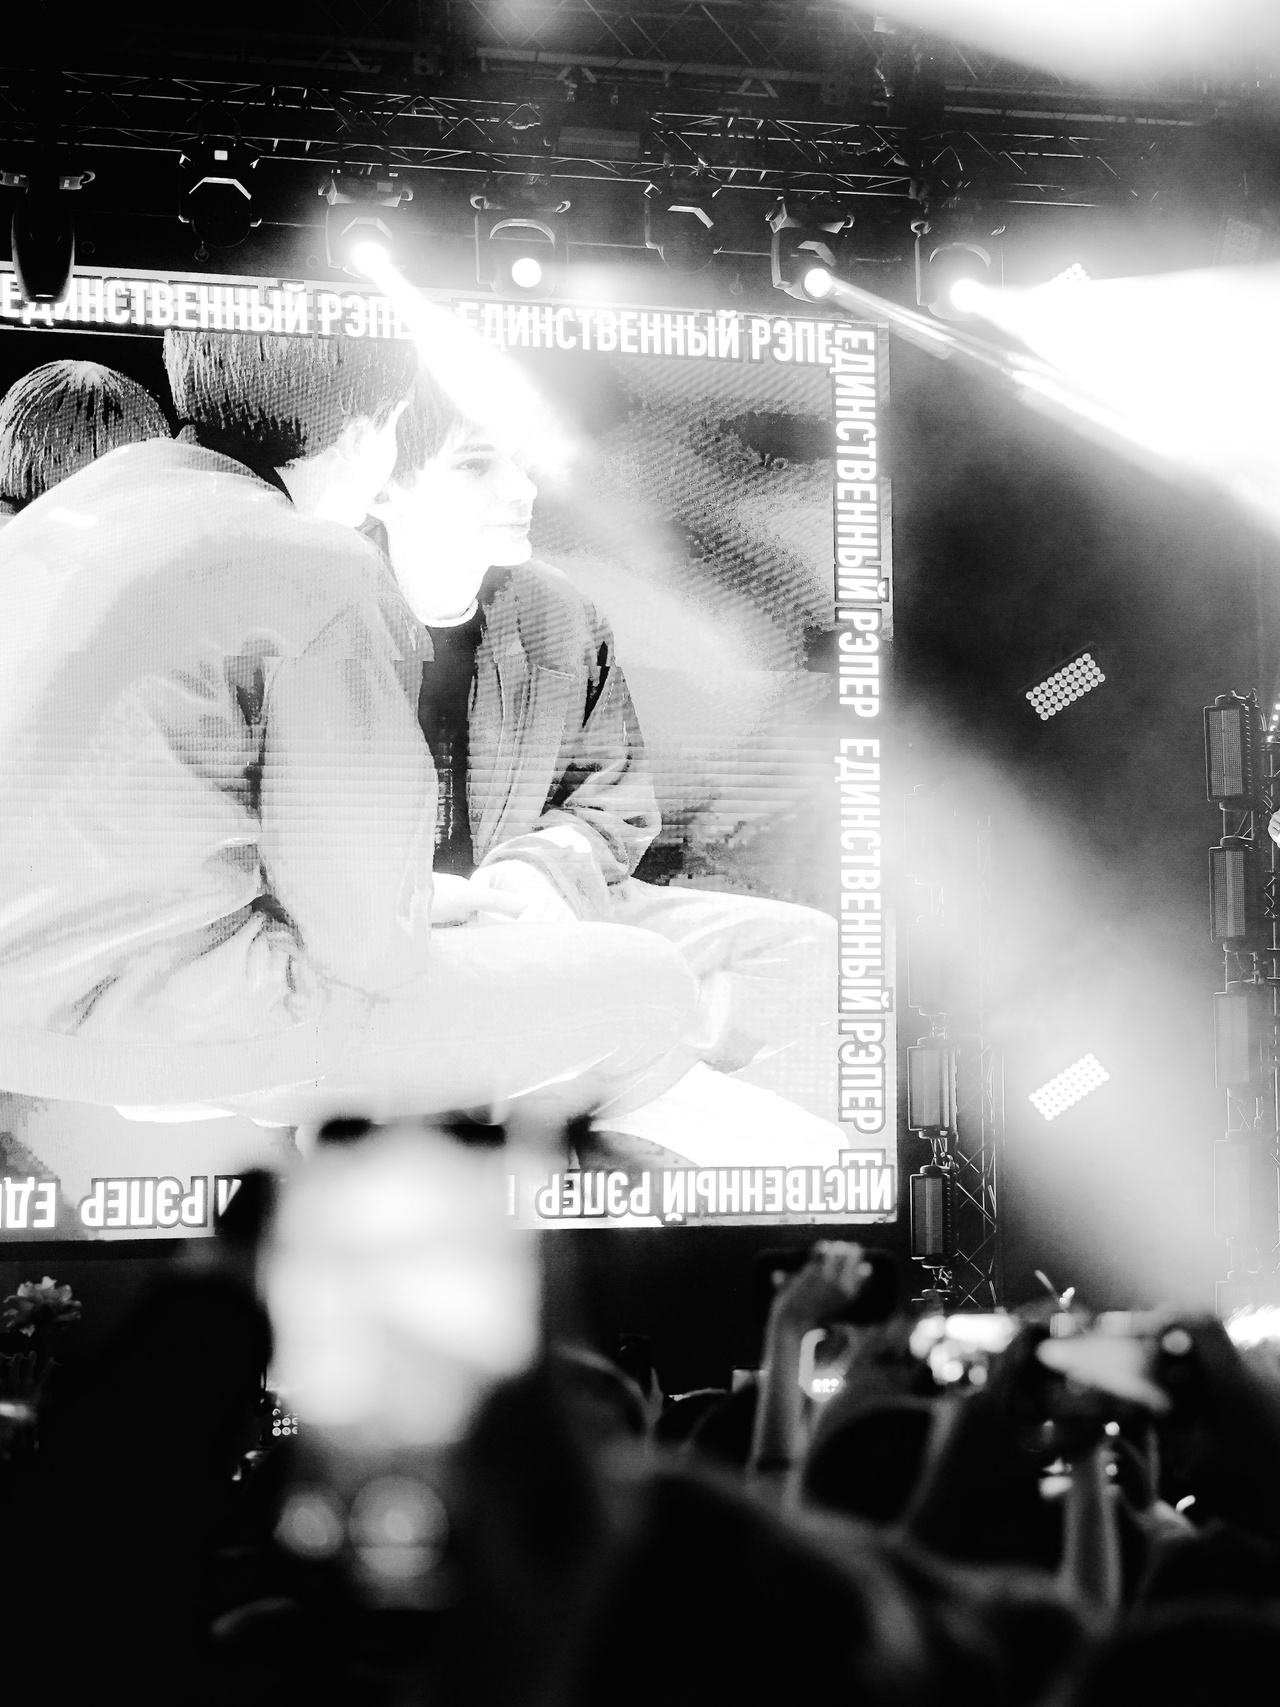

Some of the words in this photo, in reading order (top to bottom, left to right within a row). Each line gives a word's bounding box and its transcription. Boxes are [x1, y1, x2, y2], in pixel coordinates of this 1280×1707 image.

[322, 293, 413, 339] РЭПЕ
[459, 300, 740, 360] ЕДИНСТВЕННЫЙ
[752, 317, 852, 364] РЭПЕ
[829, 329, 887, 600] ЕДИНСТВЕННЫЙ
[838, 611, 880, 718] РЭПЕР
[834, 738, 891, 1013] ЕДИНСТВЕННЫЙ
[842, 1022, 884, 1131] РЭПЕР
[81, 1179, 204, 1228] РЭПЕР
[539, 1172, 650, 1217] РЭПЕР
